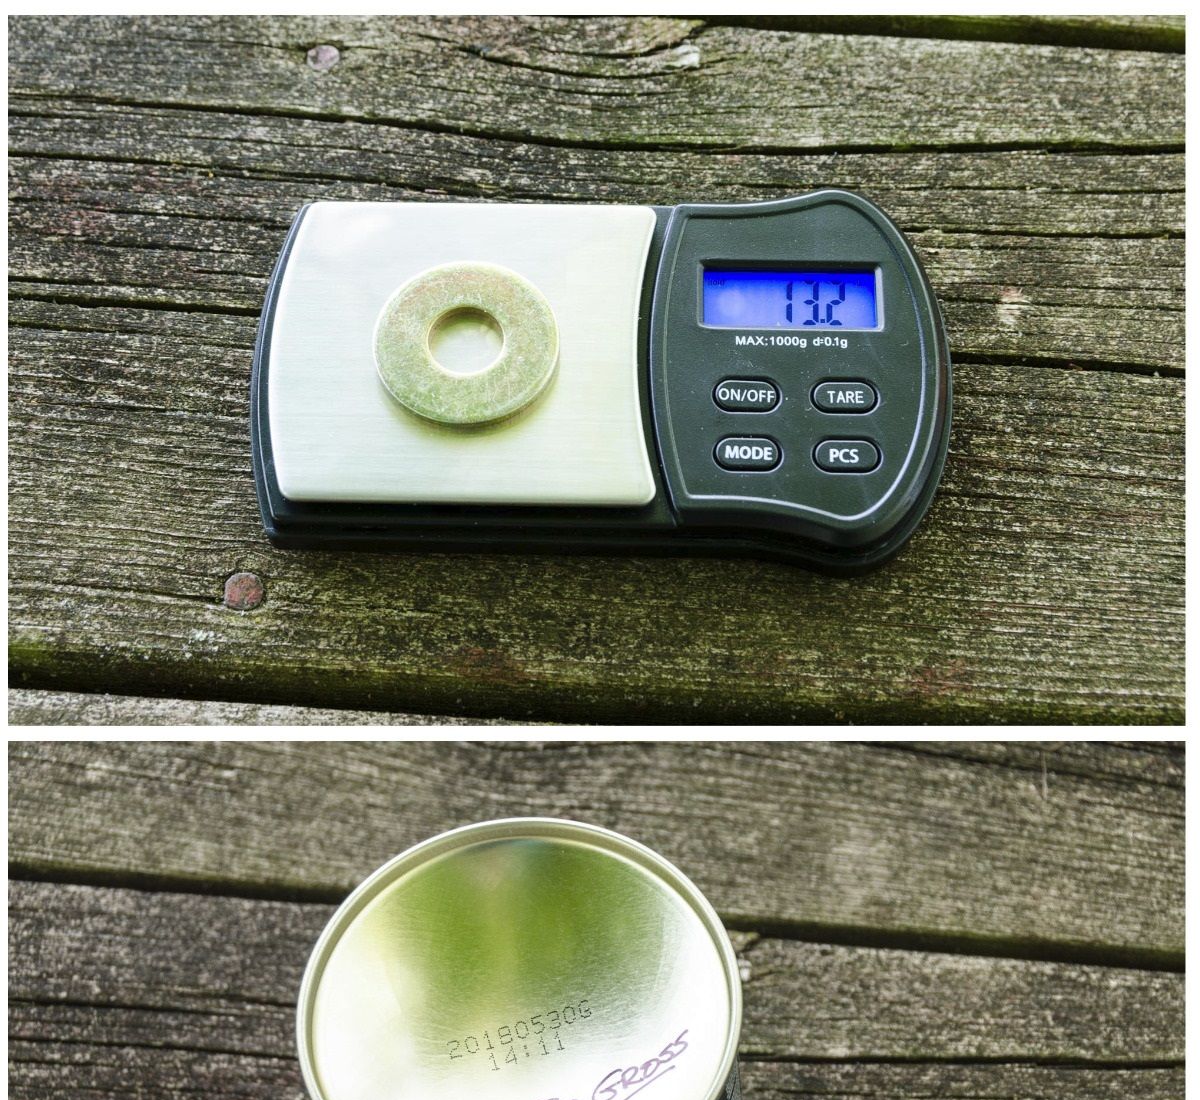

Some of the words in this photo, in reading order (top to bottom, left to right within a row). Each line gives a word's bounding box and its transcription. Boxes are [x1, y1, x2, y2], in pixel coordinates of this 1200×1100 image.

[786, 279, 846, 326] 13.2
[735, 336, 807, 348] MAX:1000g
[717, 387, 775, 403] ON/OFF
[827, 390, 865, 404] TARE
[724, 445, 773, 461] MODE
[828, 448, 859, 464] PCS
[488, 1030, 566, 1072] 14:11
